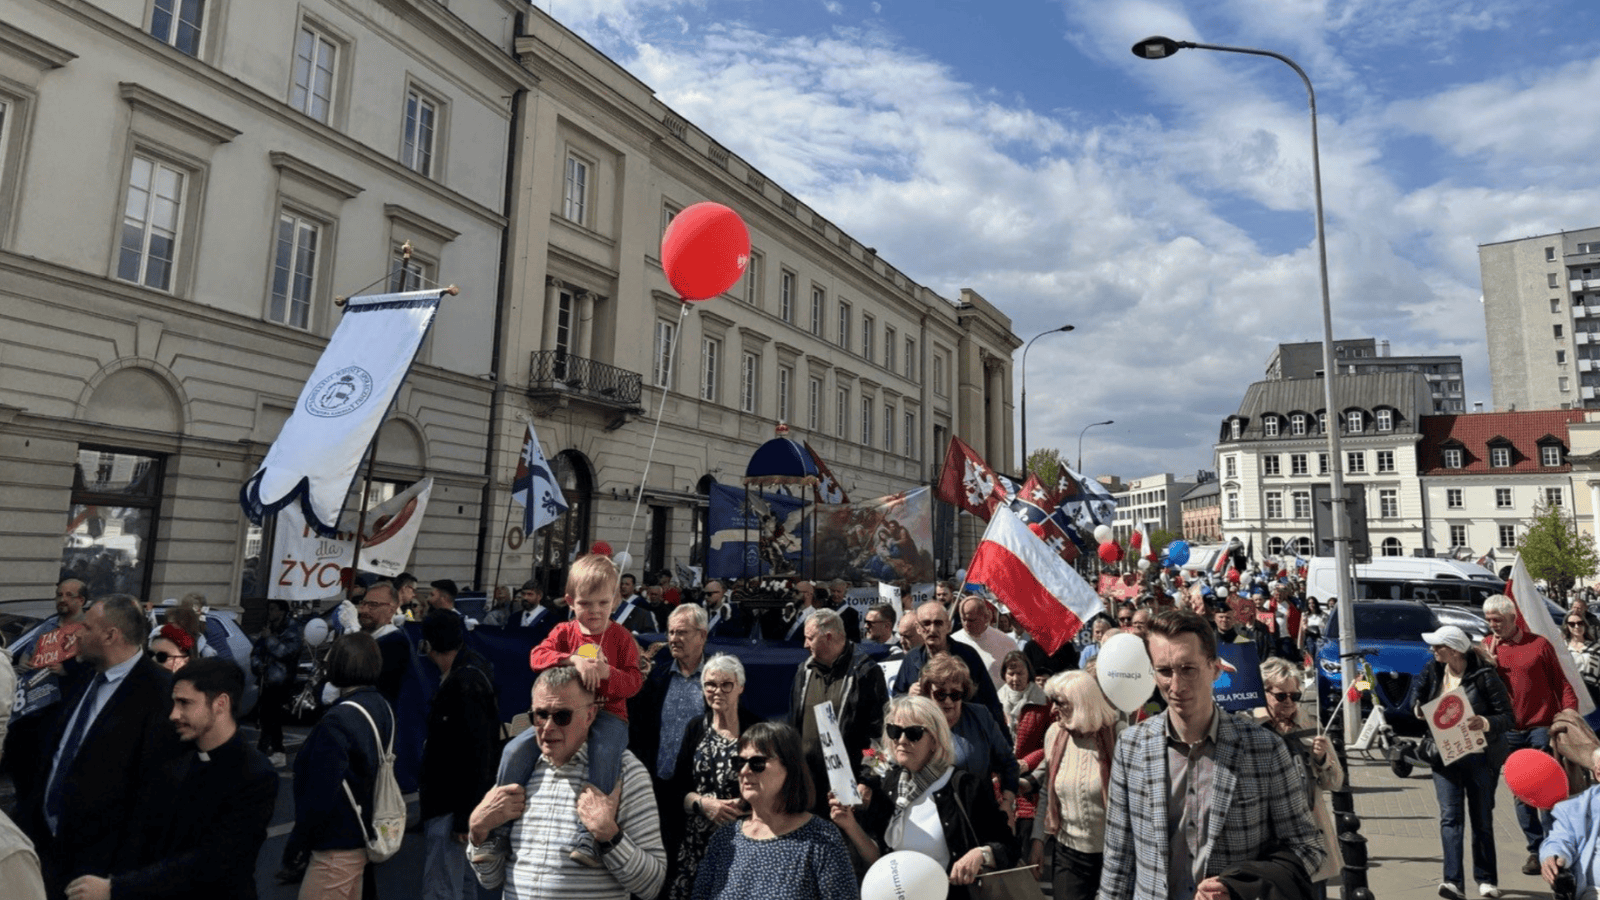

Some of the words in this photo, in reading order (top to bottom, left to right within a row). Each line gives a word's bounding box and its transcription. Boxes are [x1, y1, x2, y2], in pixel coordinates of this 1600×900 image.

[315, 541, 343, 557] dla
[278, 554, 341, 588] ŻYC
[1232, 691, 1259, 700] POLSKI
